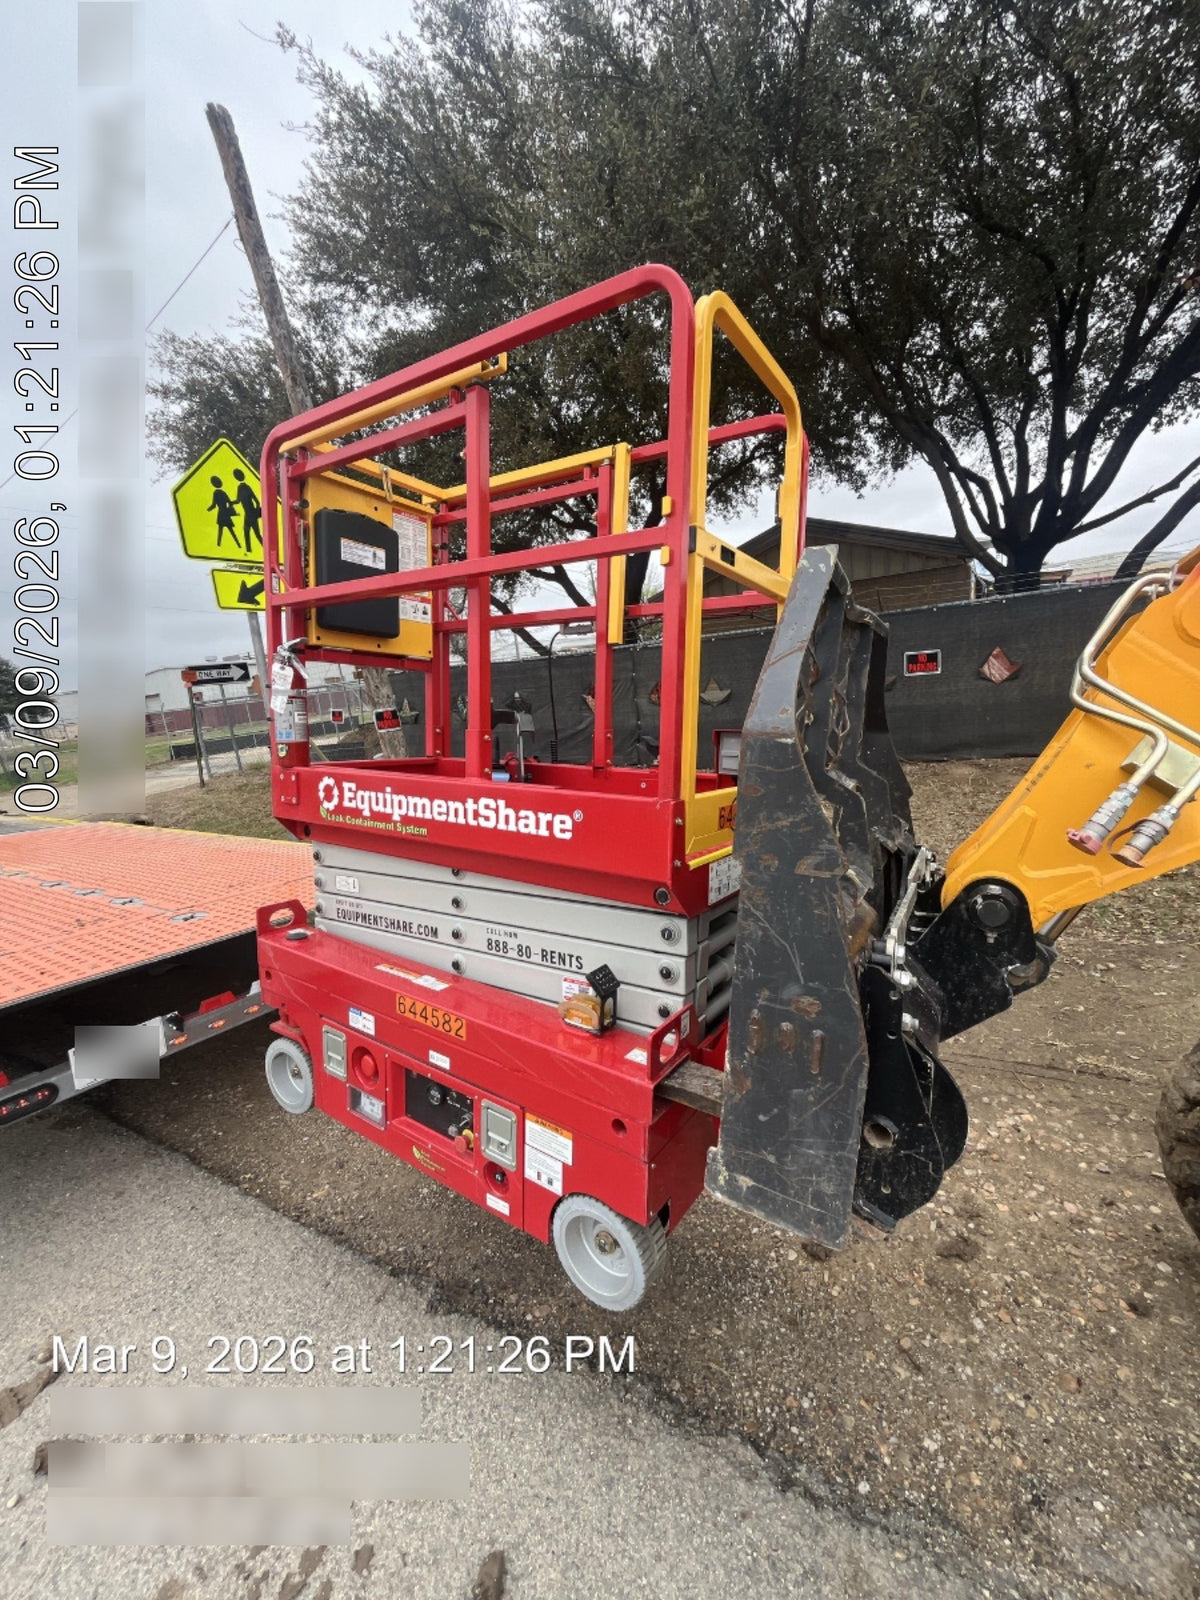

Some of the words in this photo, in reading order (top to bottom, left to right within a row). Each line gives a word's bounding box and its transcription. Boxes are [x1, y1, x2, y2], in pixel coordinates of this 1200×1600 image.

[917, 654, 928, 663] NO
[396, 822, 428, 836] System
[336, 907, 440, 939] EQUIPMENTSHARE.COM
[487, 938, 584, 970] 888-80-RENTS
[398, 995, 465, 1039] 644582
